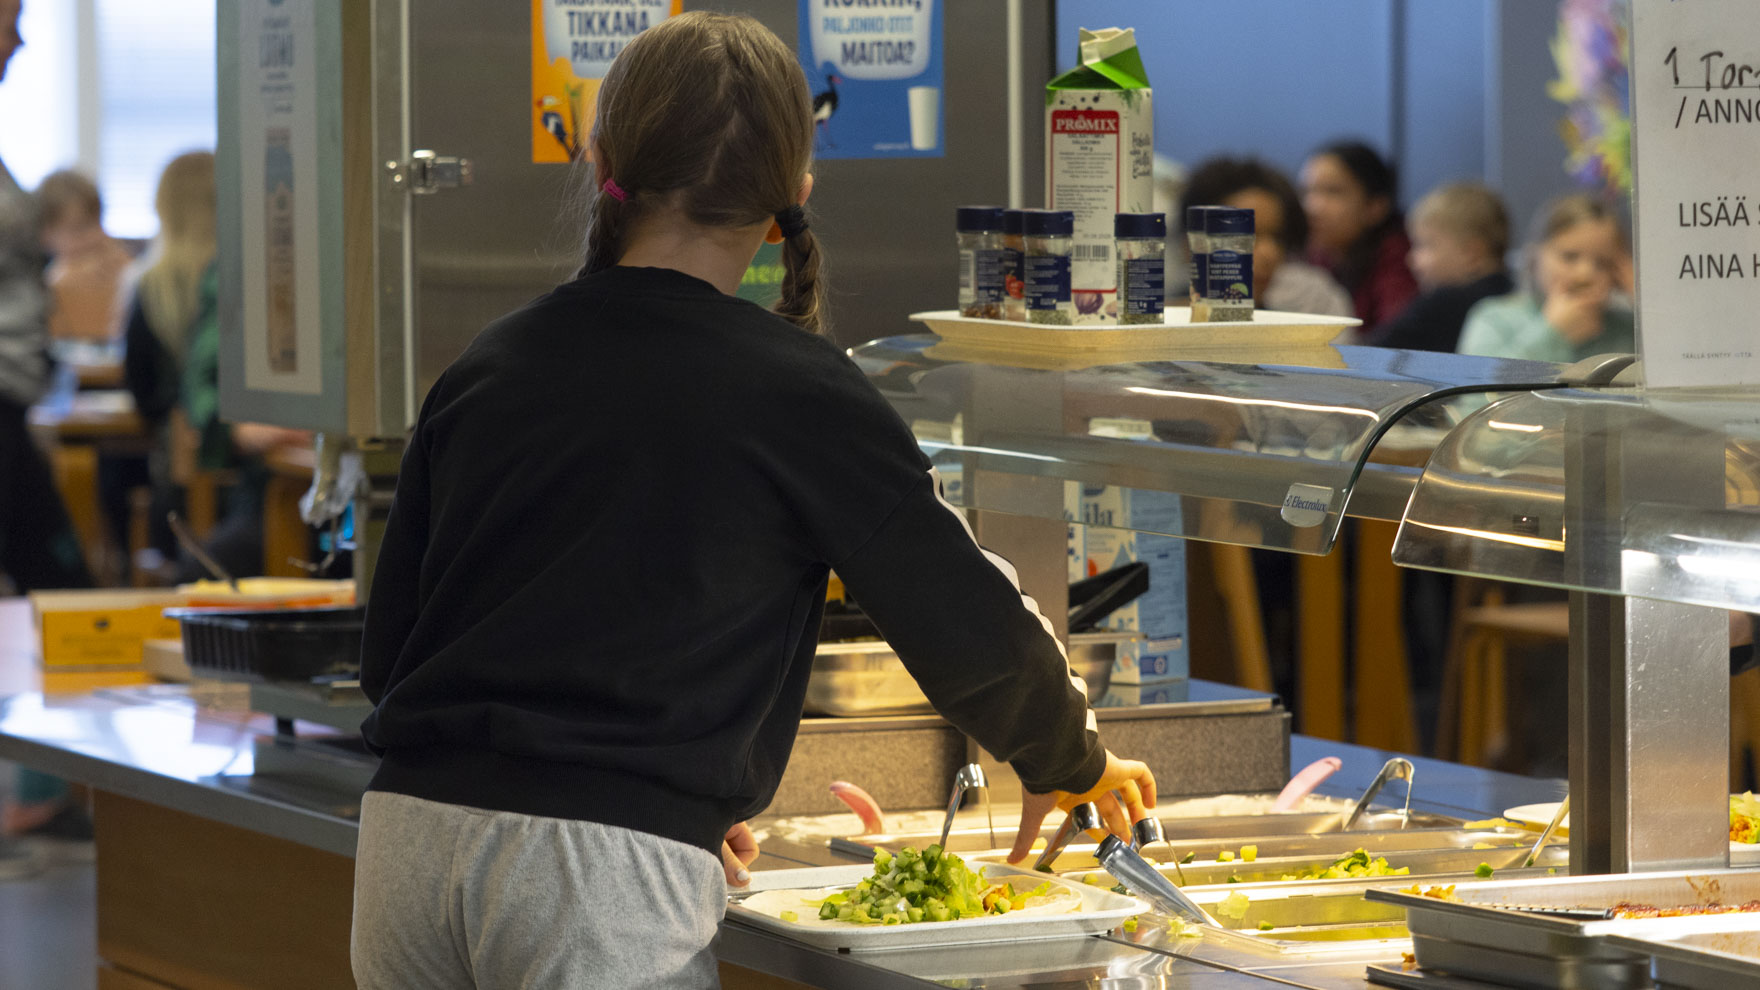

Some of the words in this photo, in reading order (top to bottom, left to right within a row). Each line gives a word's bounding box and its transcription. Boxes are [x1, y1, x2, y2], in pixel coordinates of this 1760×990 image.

[567, 11, 650, 36] TIKKANA
[822, 15, 884, 34] PALJONKO
[571, 41, 624, 62] PAIKA
[841, 41, 915, 65] MAITOA?
[1664, 46, 1680, 86] 1
[1700, 50, 1760, 92] Tor
[1694, 98, 1760, 124] ANN
[1055, 116, 1117, 131] PROMIX
[1678, 195, 1750, 228] LISÄÄ
[1678, 253, 1744, 280] AINA
[1291, 495, 1328, 513] Electrolux
